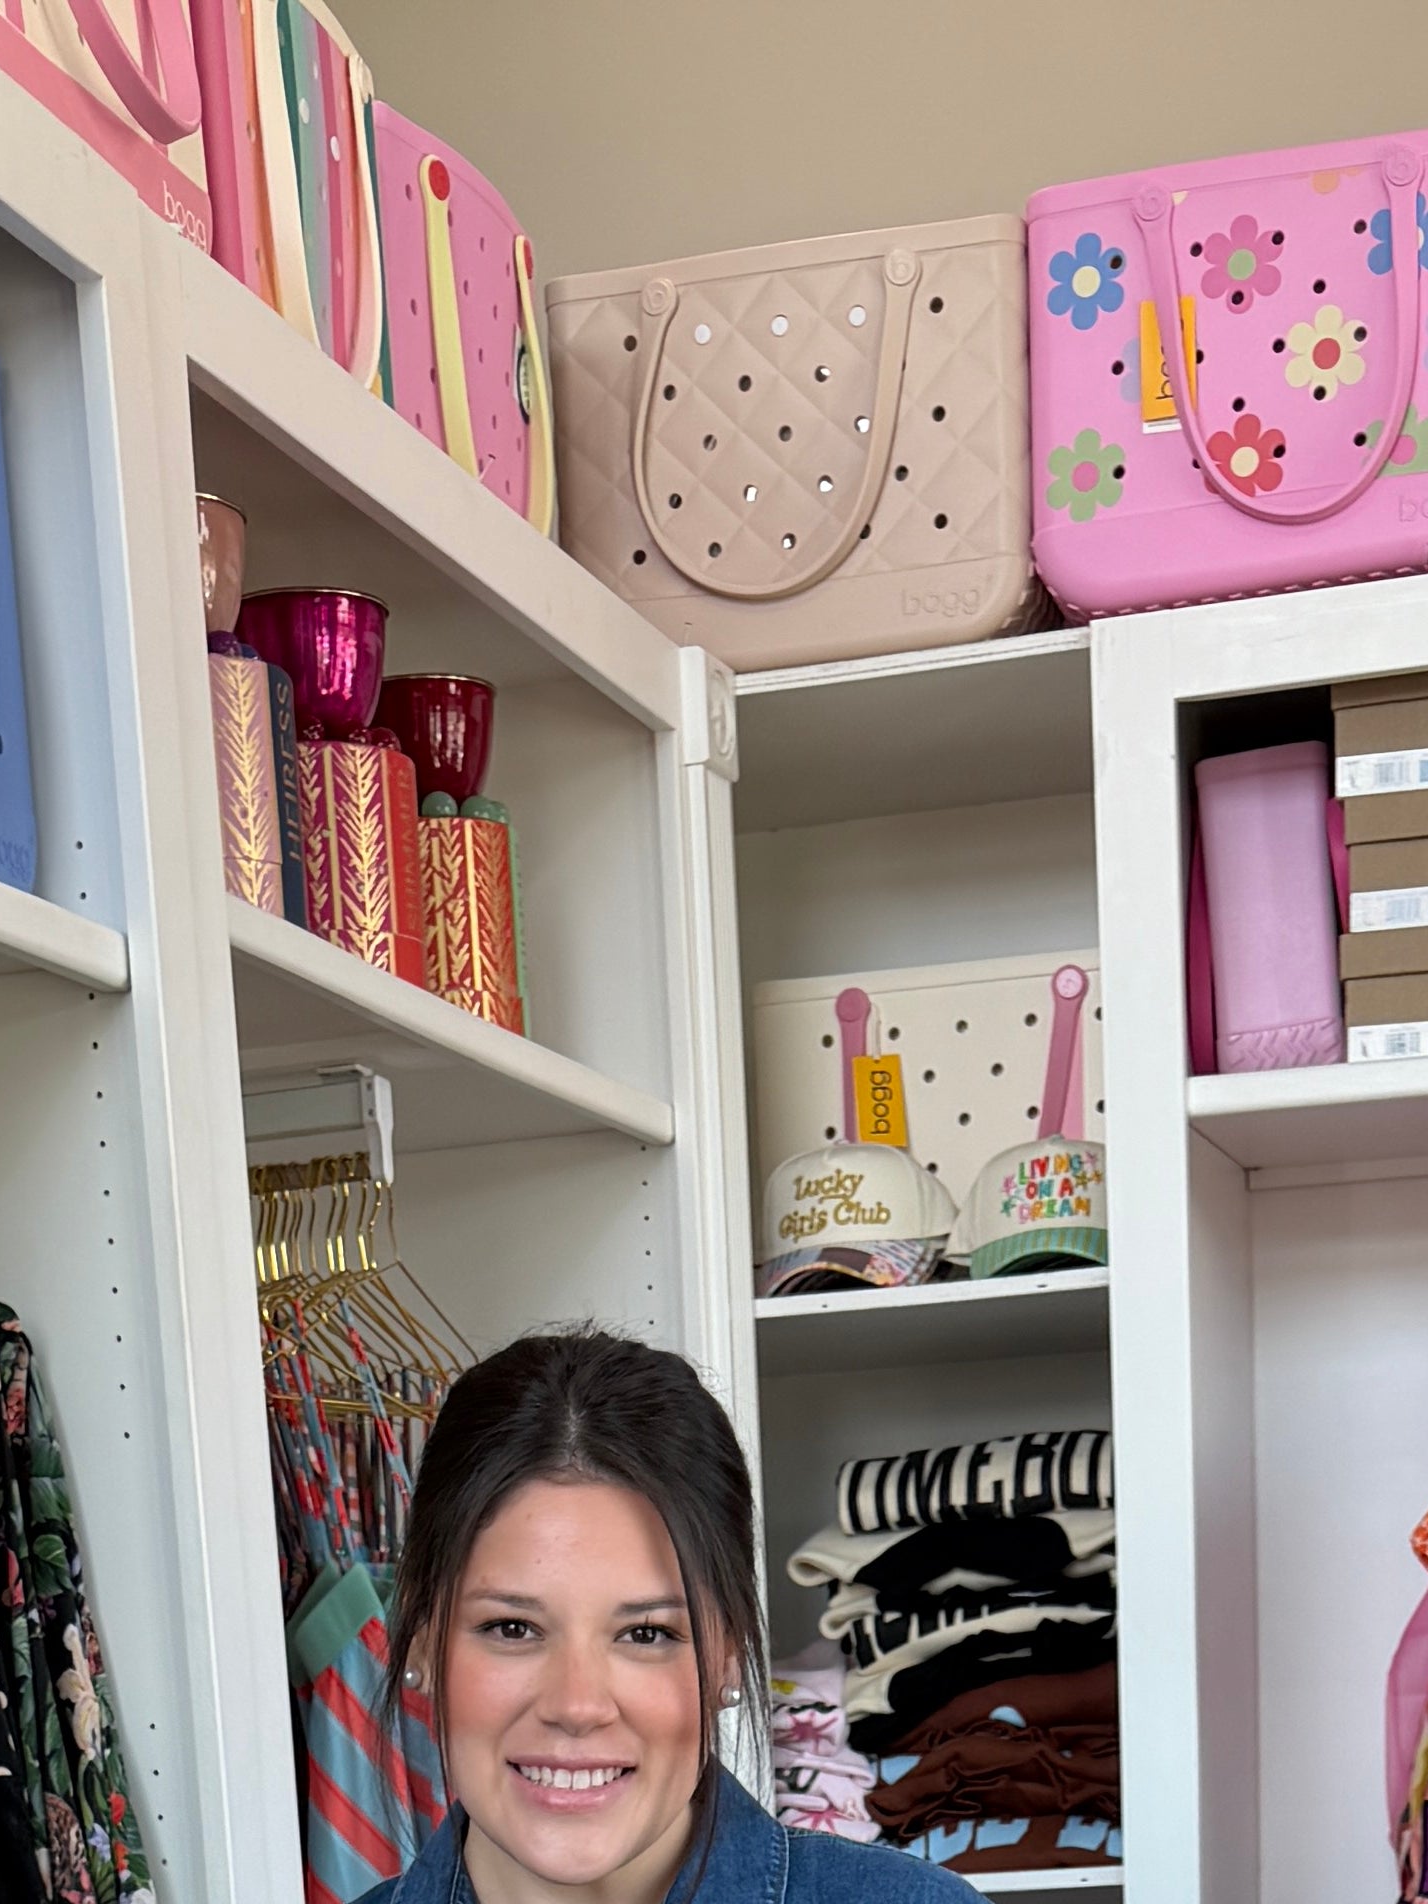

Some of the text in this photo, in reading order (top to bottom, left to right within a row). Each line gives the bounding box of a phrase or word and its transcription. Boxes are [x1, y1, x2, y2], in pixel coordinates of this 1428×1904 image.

[900, 590, 979, 617] bogg
[870, 1070, 893, 1134] bogg
[793, 1168, 864, 1204] Lucky
[1026, 1177, 1074, 1200] ON A
[778, 1201, 891, 1244] Girls Club
[1018, 1195, 1091, 1224] DREAM
